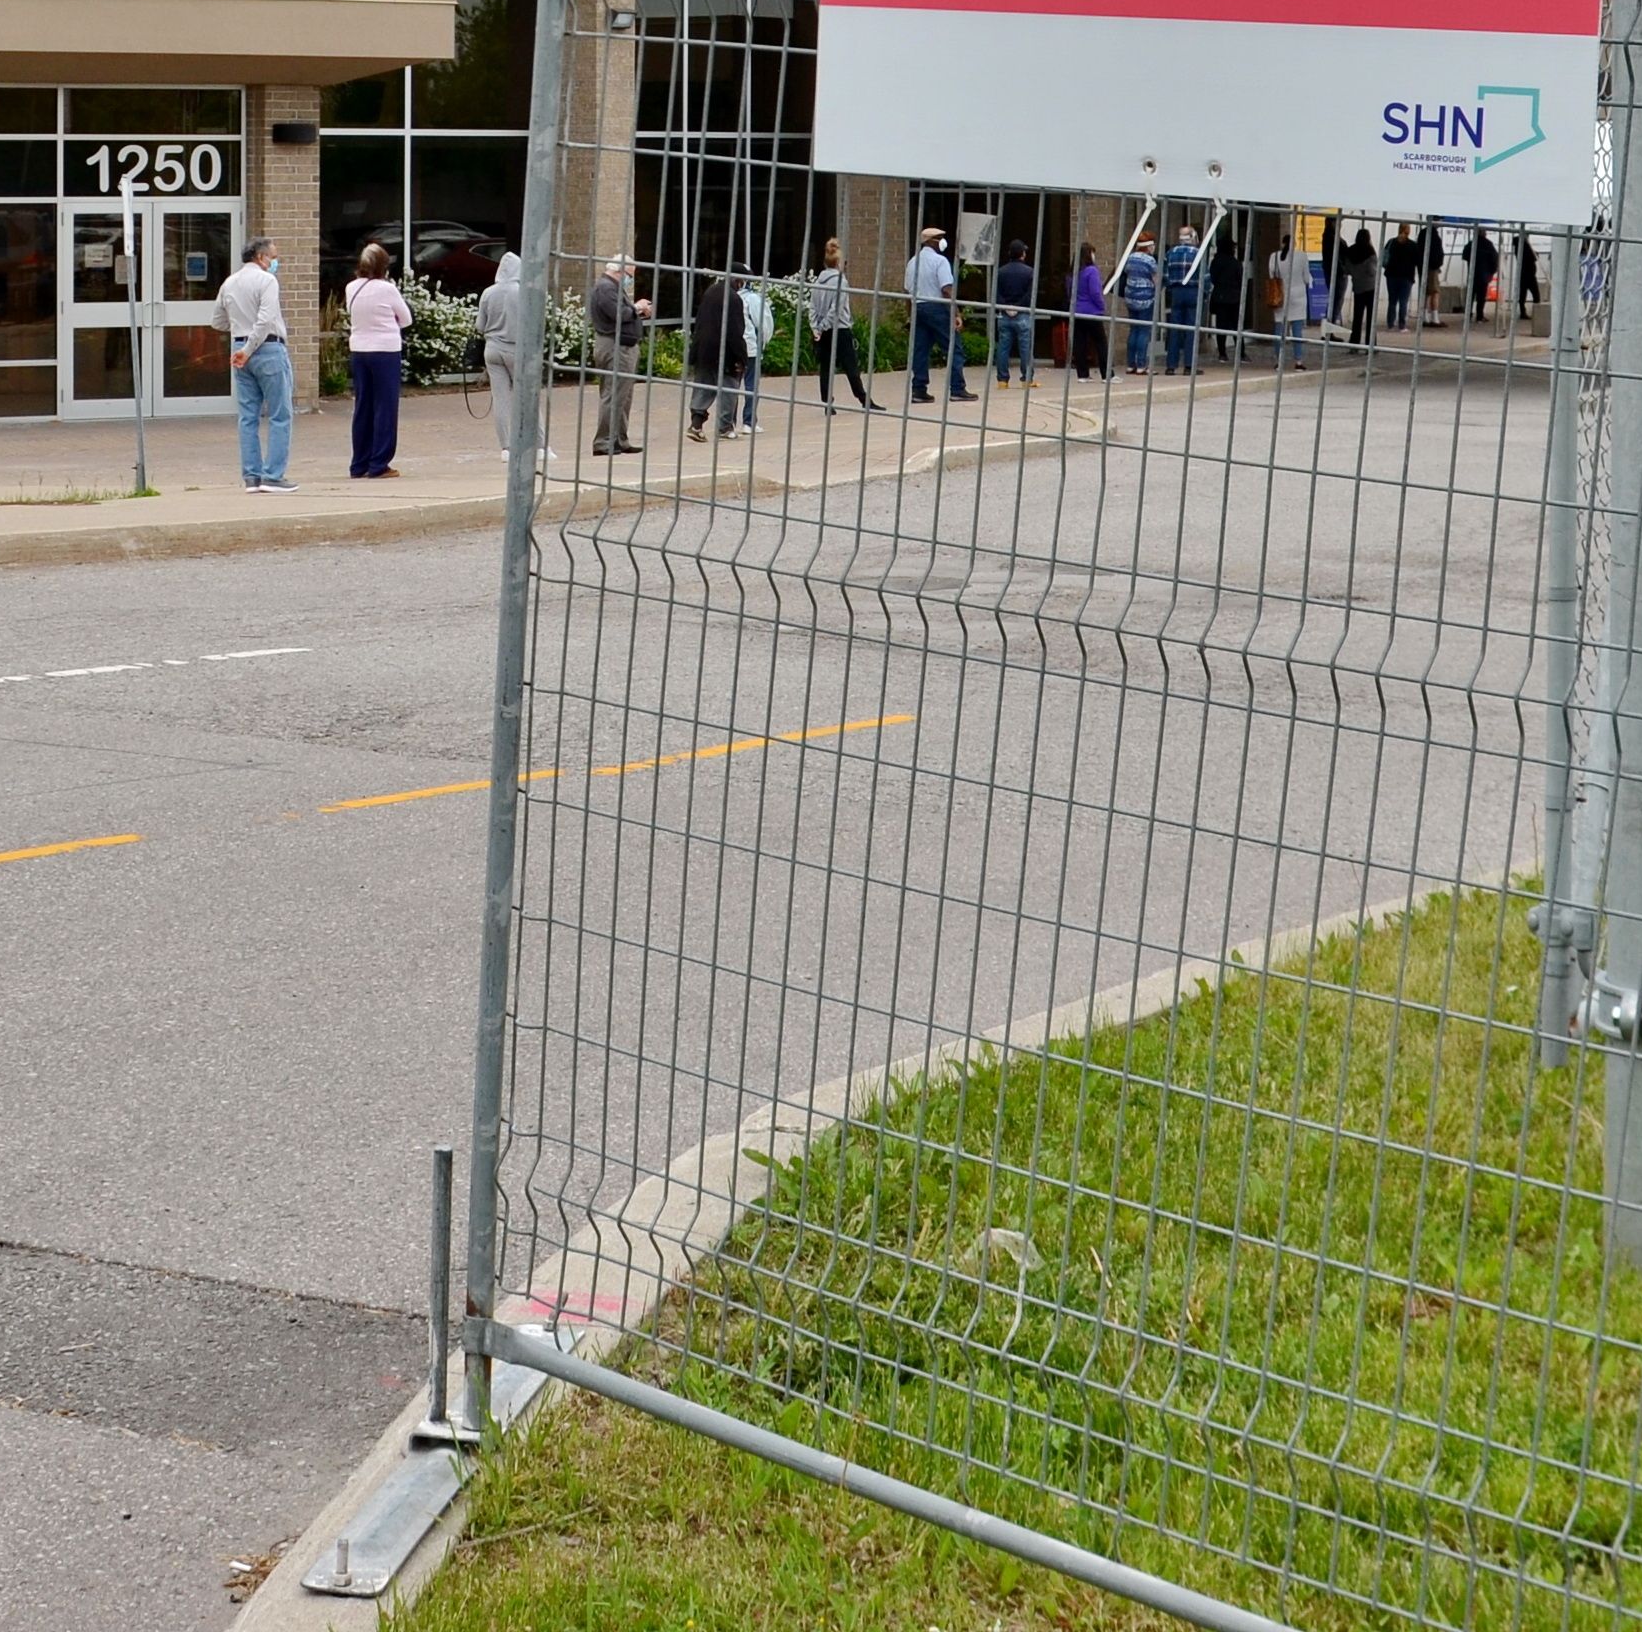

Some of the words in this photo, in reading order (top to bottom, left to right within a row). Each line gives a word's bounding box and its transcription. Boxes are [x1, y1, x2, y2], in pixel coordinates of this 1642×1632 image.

[1381, 101, 1484, 149] SHN
[85, 143, 222, 193] 1250
[1392, 161, 1424, 172] HEALTH
[1425, 163, 1467, 174] NETWORK
[1403, 152, 1467, 164] SCARBOROUGH
